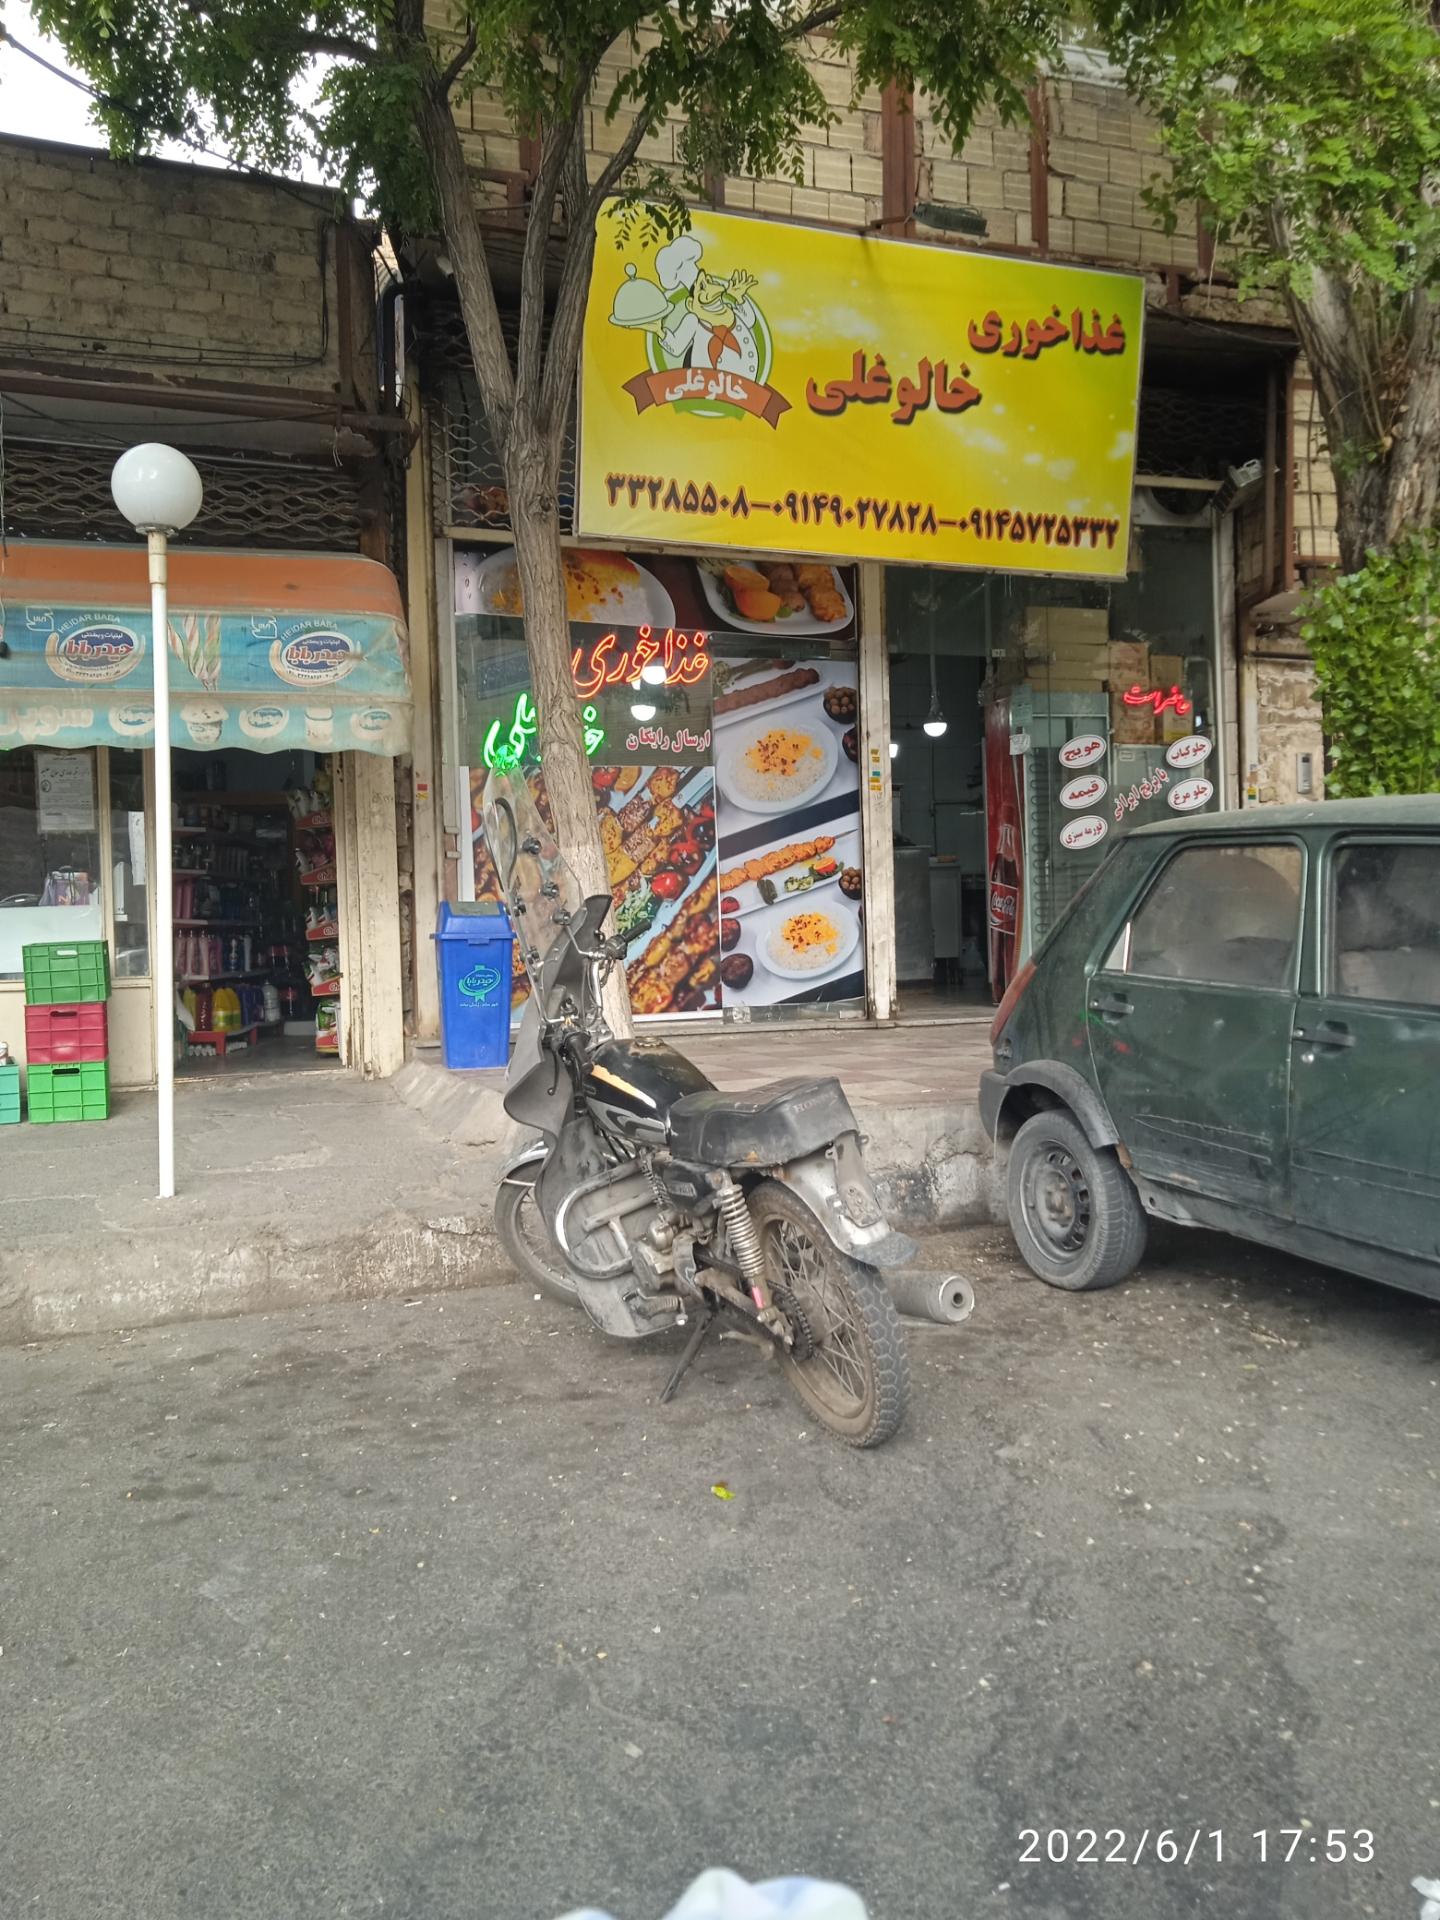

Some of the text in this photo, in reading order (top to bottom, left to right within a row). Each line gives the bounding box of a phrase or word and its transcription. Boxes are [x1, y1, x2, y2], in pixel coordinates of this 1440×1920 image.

[57, 613, 92, 633] HEIDAR
[281, 620, 312, 640] HEIDAR
[625, 726, 711, 752] ارسال رایگان
[1068, 779, 1100, 801] قیمه
[1173, 789, 1191, 806] مرغ
